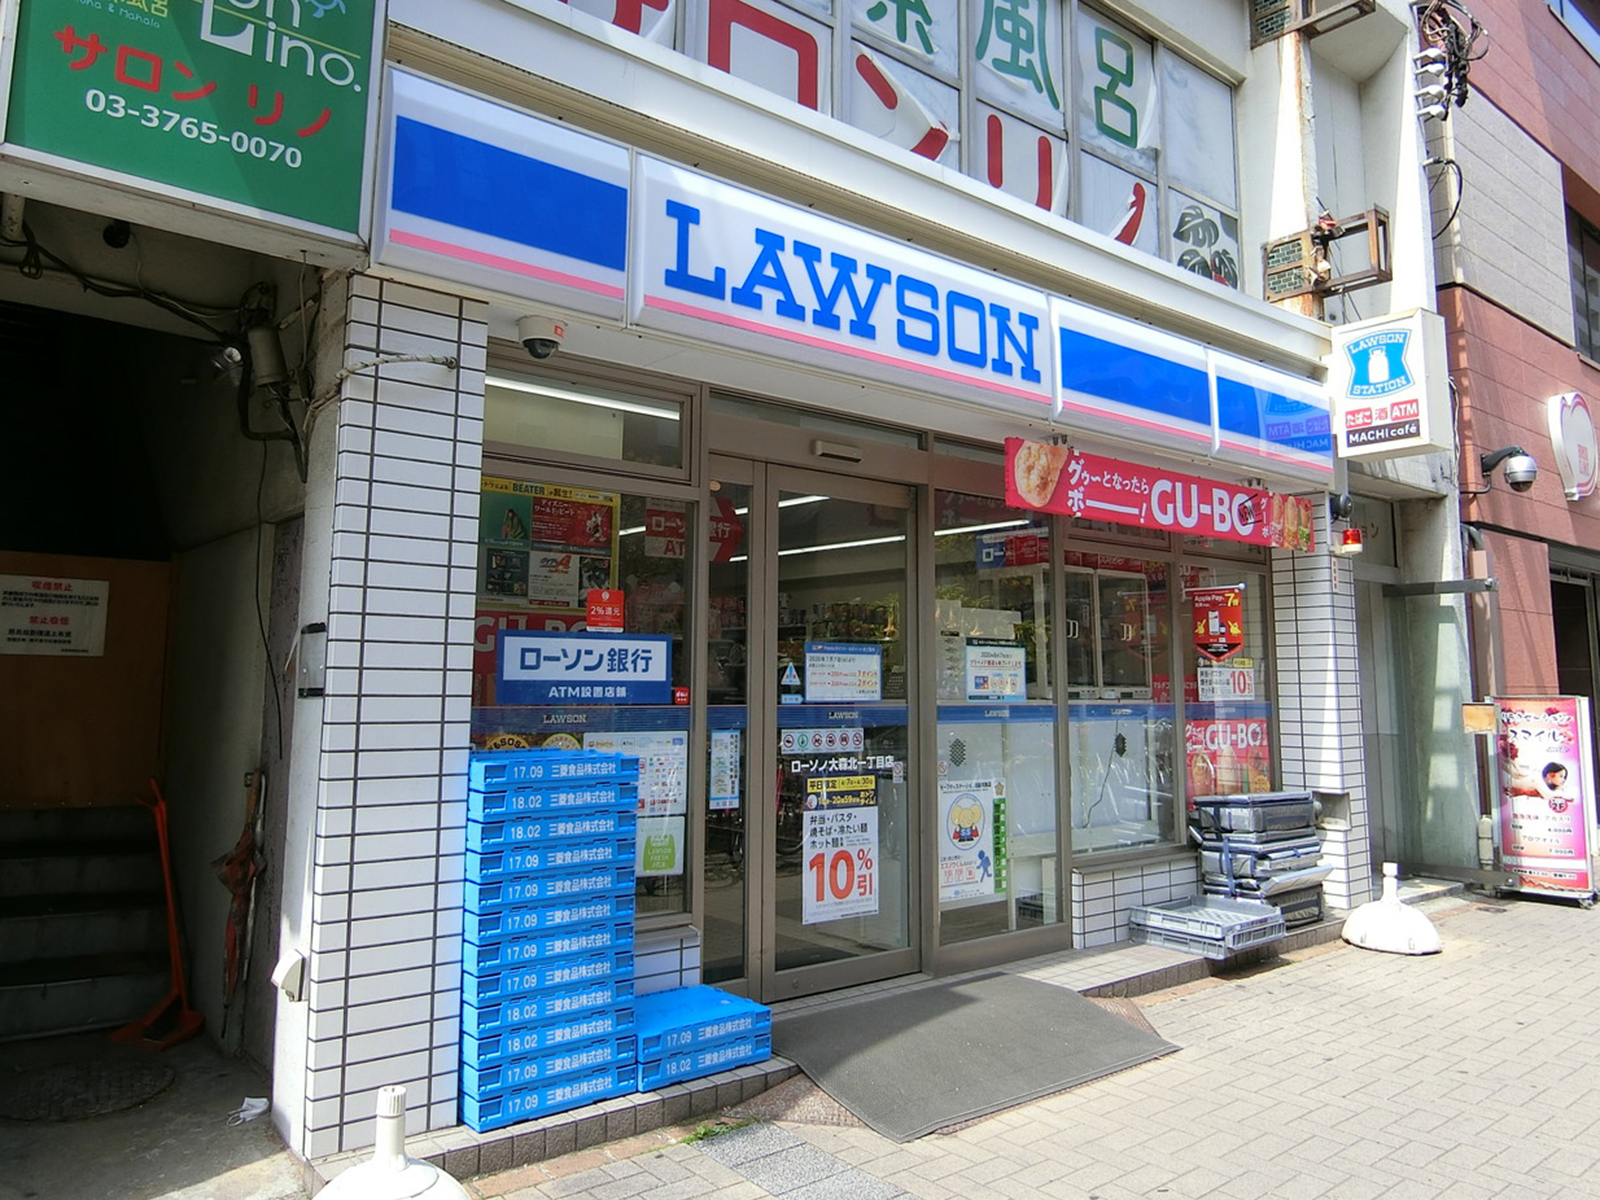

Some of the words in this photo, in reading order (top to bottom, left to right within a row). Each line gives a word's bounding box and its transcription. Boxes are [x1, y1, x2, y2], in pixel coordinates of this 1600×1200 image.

[119, 8, 160, 29] Mahalo
[55, 25, 217, 101] サロン
[248, 83, 332, 138] リノ
[85, 88, 303, 168] 03-3765-0070
[664, 199, 1041, 384] LAWSON
[1349, 333, 1406, 355] LAWSON
[1352, 376, 1408, 396] STATION
[1391, 403, 1418, 418] ATM
[1349, 428, 1389, 445] MACHI
[512, 483, 546, 496] BEATER
[1151, 479, 1255, 537] GU-BO
[520, 647, 653, 673] ローソン銀行
[549, 686, 627, 699] ATM設置店舗
[543, 714, 587, 724] LAWSON
[513, 765, 544, 779] 17.09
[551, 762, 617, 778] 三菱食品株式会社
[512, 795, 543, 809] 18.02
[550, 787, 616, 807] 三菱食品株式会社
[510, 825, 541, 839] 18.02
[549, 816, 615, 837] 三菱食品株式会社
[508, 855, 539, 869] 17.09
[547, 844, 613, 867] 三菱食品株式会社
[508, 884, 539, 899] 17.09
[546, 873, 613, 896] 三菱食品株式会社
[507, 914, 538, 929] 17.09
[546, 902, 612, 925] 三菱食品株式会社
[507, 945, 538, 960] 17.09
[545, 932, 612, 955] 三菱食品株式会社
[506, 974, 538, 990] 17.09
[545, 961, 612, 982] 三菱食品株式会社
[507, 1004, 538, 1021] 18.02
[545, 990, 613, 1014] 三菱食品株式会社
[507, 1035, 538, 1051] 18.02
[545, 1018, 613, 1044] 三菱食品株式会社
[666, 1031, 692, 1047] 17.09
[507, 1064, 538, 1082] 17.09
[545, 1047, 613, 1070] 三菱食品株式会社
[666, 1058, 692, 1075] 18.02
[508, 1095, 539, 1113] 17.09
[546, 1076, 613, 1105] 三菱食品株式会社
